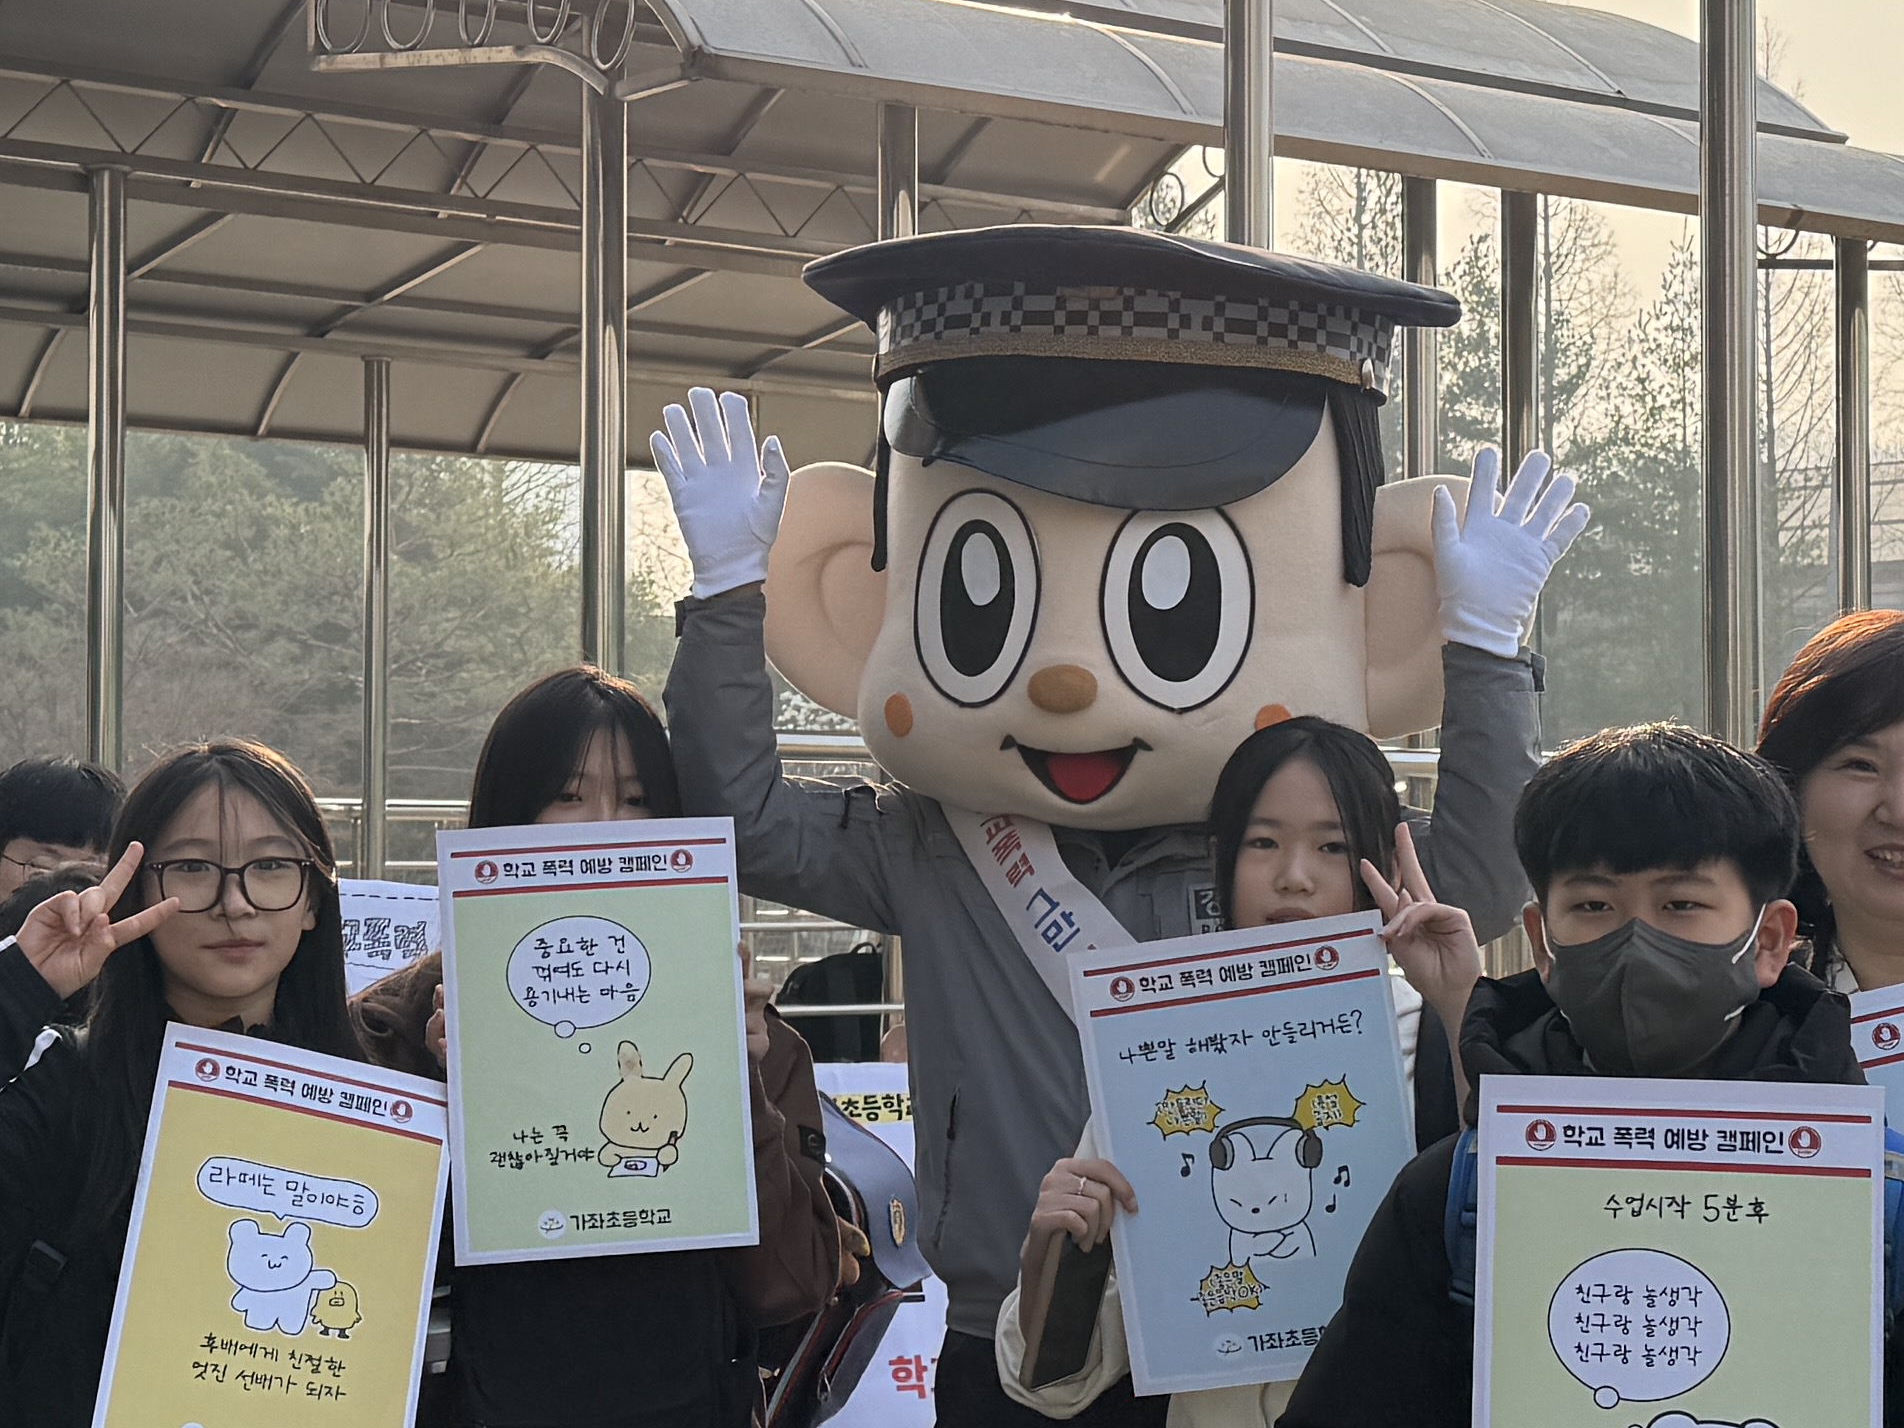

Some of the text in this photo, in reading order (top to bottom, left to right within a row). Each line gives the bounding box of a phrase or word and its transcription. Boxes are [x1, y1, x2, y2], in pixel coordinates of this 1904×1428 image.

[503, 853, 667, 879] 학교 폭력 예방 캠페인
[534, 934, 625, 959] 중요한 건
[593, 958, 631, 977] 다시
[1139, 953, 1313, 993] 학교 폭력 예방 캠페인
[523, 982, 640, 1007] 용기내는 마음
[1119, 1009, 1363, 1065] 나쁜말 해봤자 안들리거든?
[225, 1065, 387, 1117] 학교 폭력 예방 캠페인
[832, 1093, 913, 1122] 초등학
[513, 1124, 569, 1144] 나는 꼭
[1562, 1125, 1784, 1154] 학교 폭력 예방 캠페인
[209, 1166, 276, 1197] 라떼는
[569, 1208, 672, 1231] 가좌초등학교
[1603, 1193, 1691, 1220] 수업시작
[1574, 1284, 1703, 1308] 친구랑 놀생각
[1574, 1312, 1703, 1337] 친구랑 놀생각
[1247, 1325, 1326, 1352] 가좌초등
[199, 1332, 346, 1378] 후배에게 친절한
[1574, 1342, 1703, 1367] 친구랑 놀생각
[192, 1361, 347, 1401] 멋진 선배가 되자
[889, 1355, 937, 1400] 학
